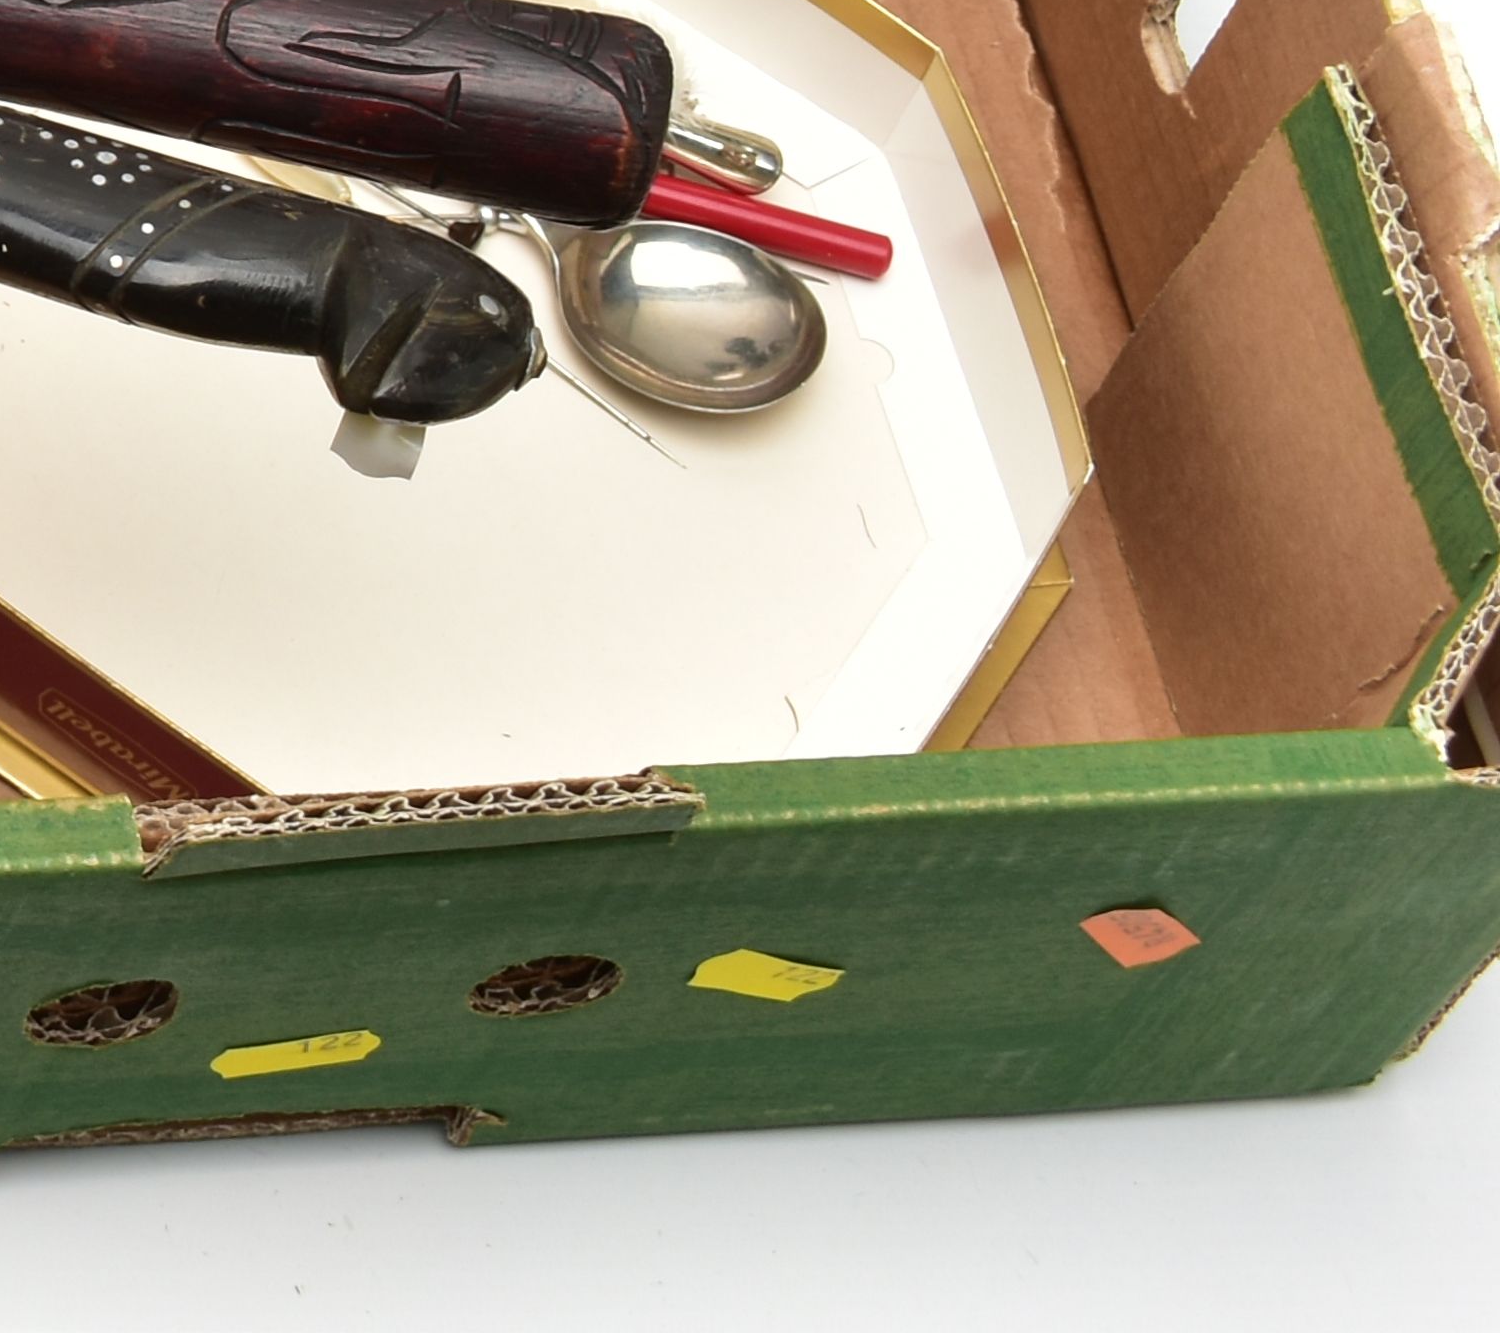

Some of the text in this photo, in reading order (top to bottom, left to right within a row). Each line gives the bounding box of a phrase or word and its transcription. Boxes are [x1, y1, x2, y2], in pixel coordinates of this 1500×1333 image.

[46, 699, 190, 800] Mirabell
[771, 966, 838, 985] 122
[298, 1032, 363, 1053] 122
